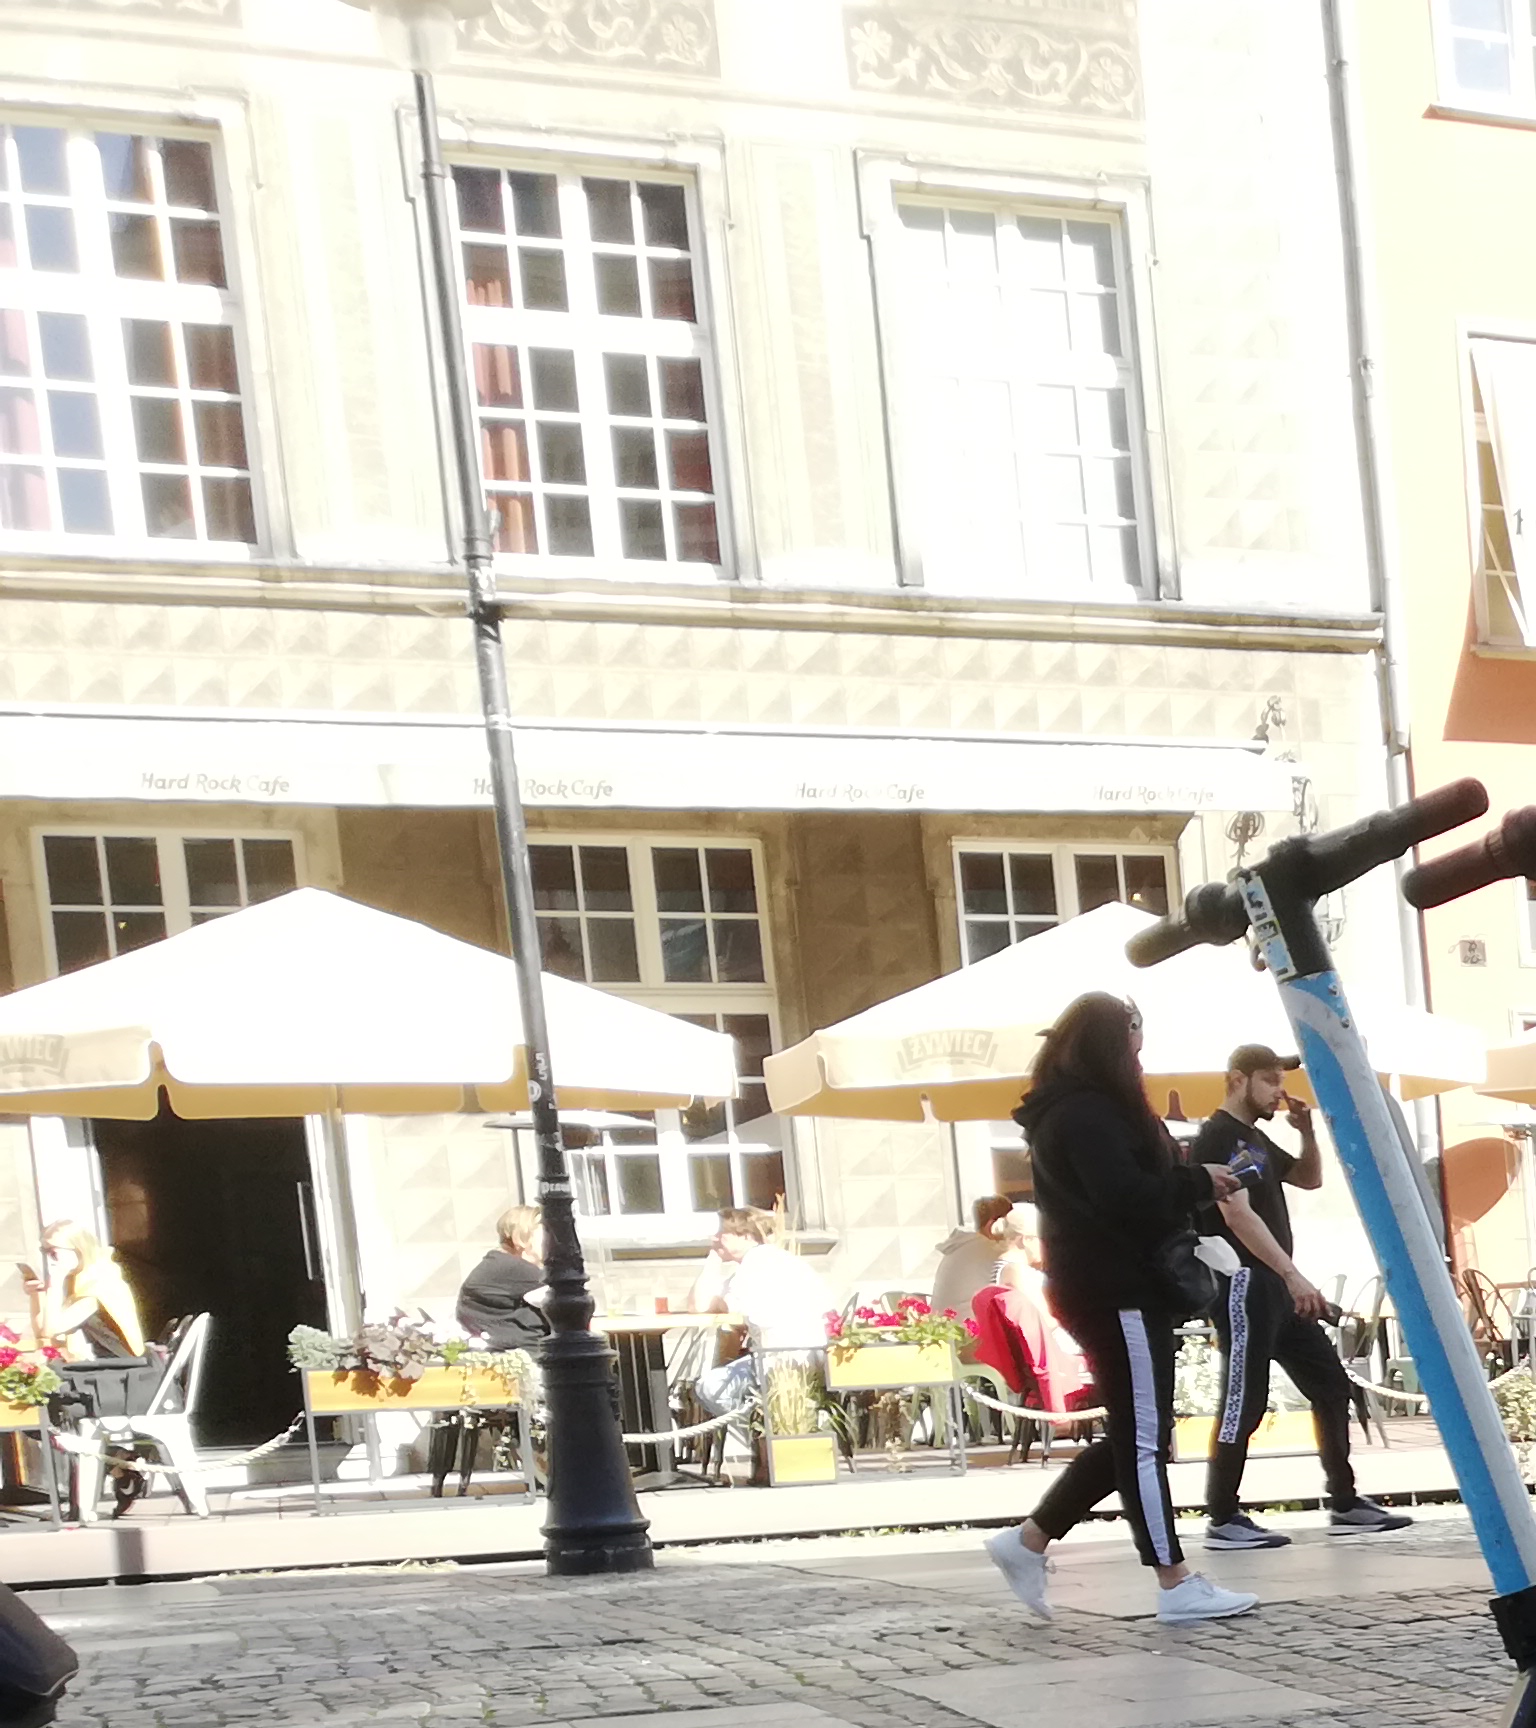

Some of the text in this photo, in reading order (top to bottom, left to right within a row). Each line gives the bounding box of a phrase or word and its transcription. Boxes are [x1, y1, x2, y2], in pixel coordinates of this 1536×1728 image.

[140, 771, 291, 796] Hard Rock Cafe
[524, 778, 568, 799] Rock
[571, 779, 613, 800] Cafe
[793, 781, 838, 801] Hard
[885, 784, 926, 804] Cafe
